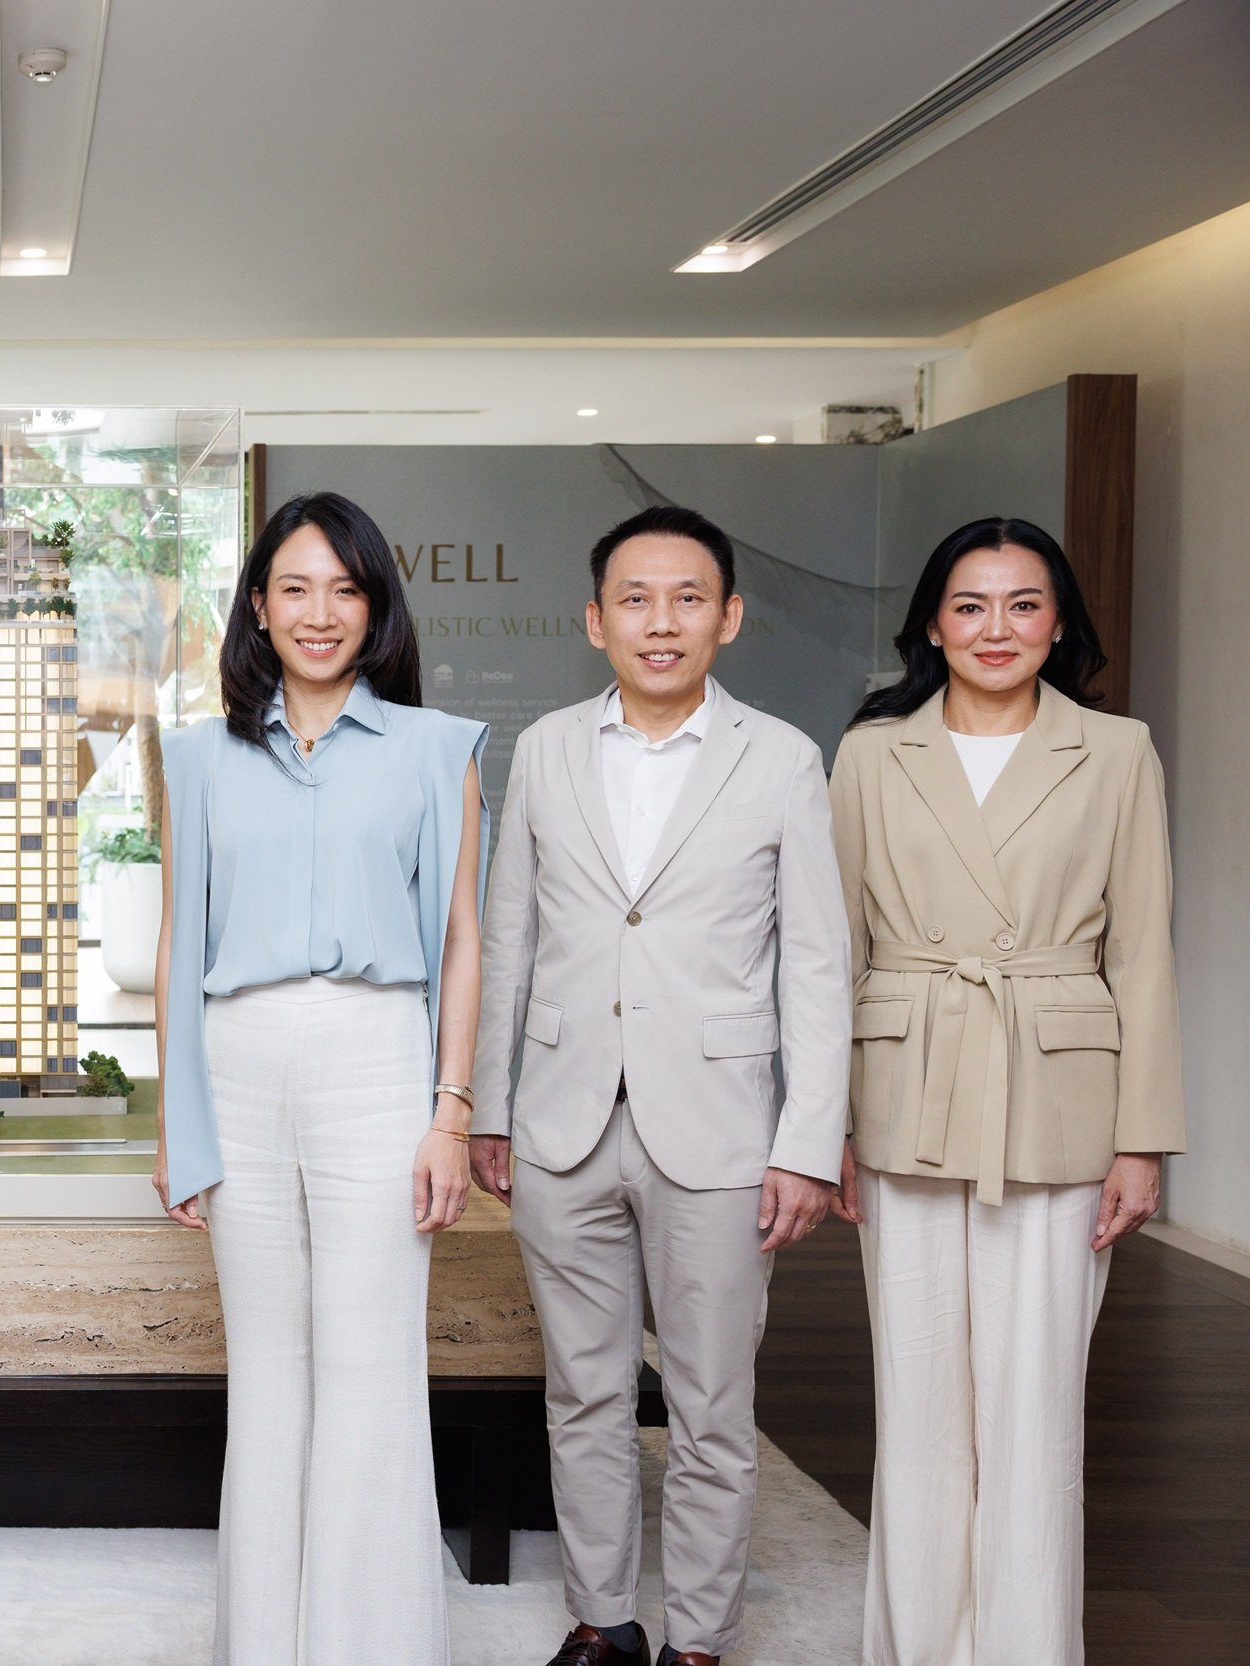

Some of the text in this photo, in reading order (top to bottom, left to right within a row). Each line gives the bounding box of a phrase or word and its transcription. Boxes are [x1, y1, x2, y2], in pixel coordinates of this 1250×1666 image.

[394, 543, 519, 584] WELL
[414, 616, 774, 637] LISTIC WELLN ON
[478, 697, 519, 708] wellness
[475, 711, 507, 721] better
[510, 713, 533, 721] care
